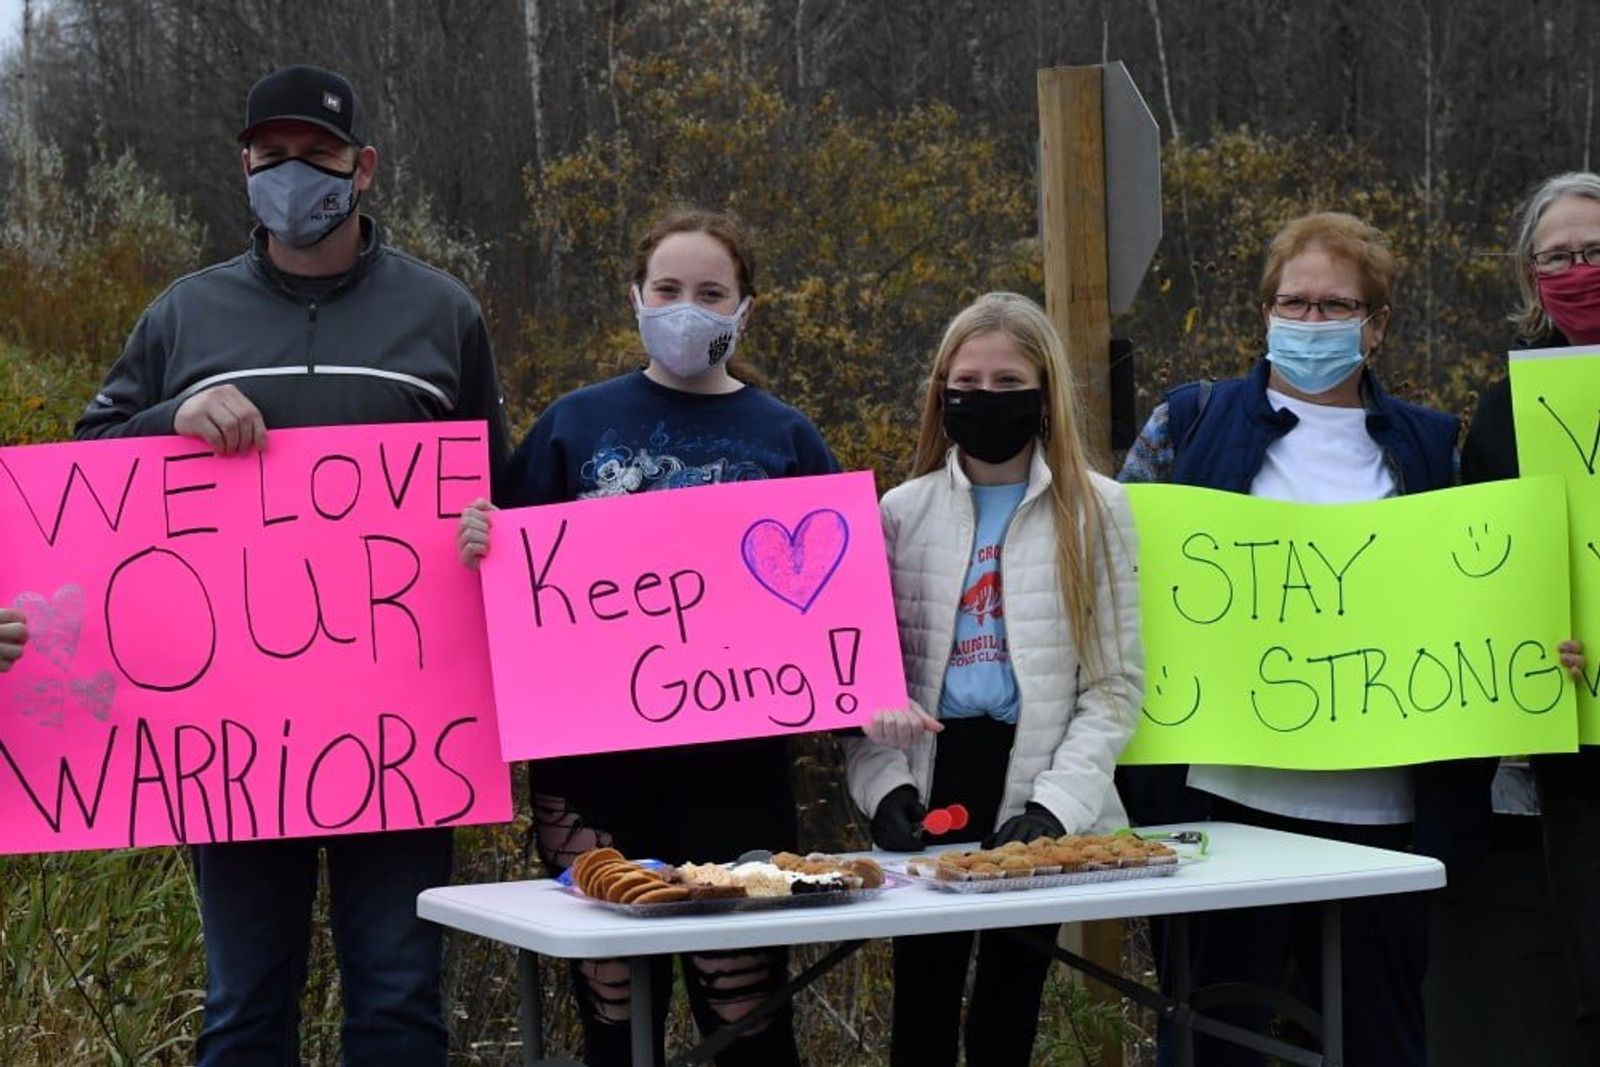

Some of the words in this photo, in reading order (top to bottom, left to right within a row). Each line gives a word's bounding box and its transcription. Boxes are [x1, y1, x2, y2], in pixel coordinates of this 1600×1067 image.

[0, 451, 218, 547] WE
[258, 436, 482, 526] LOVE
[520, 519, 705, 643] Keep
[1172, 532, 1377, 625] STAY
[1251, 638, 1564, 732] STRONG
